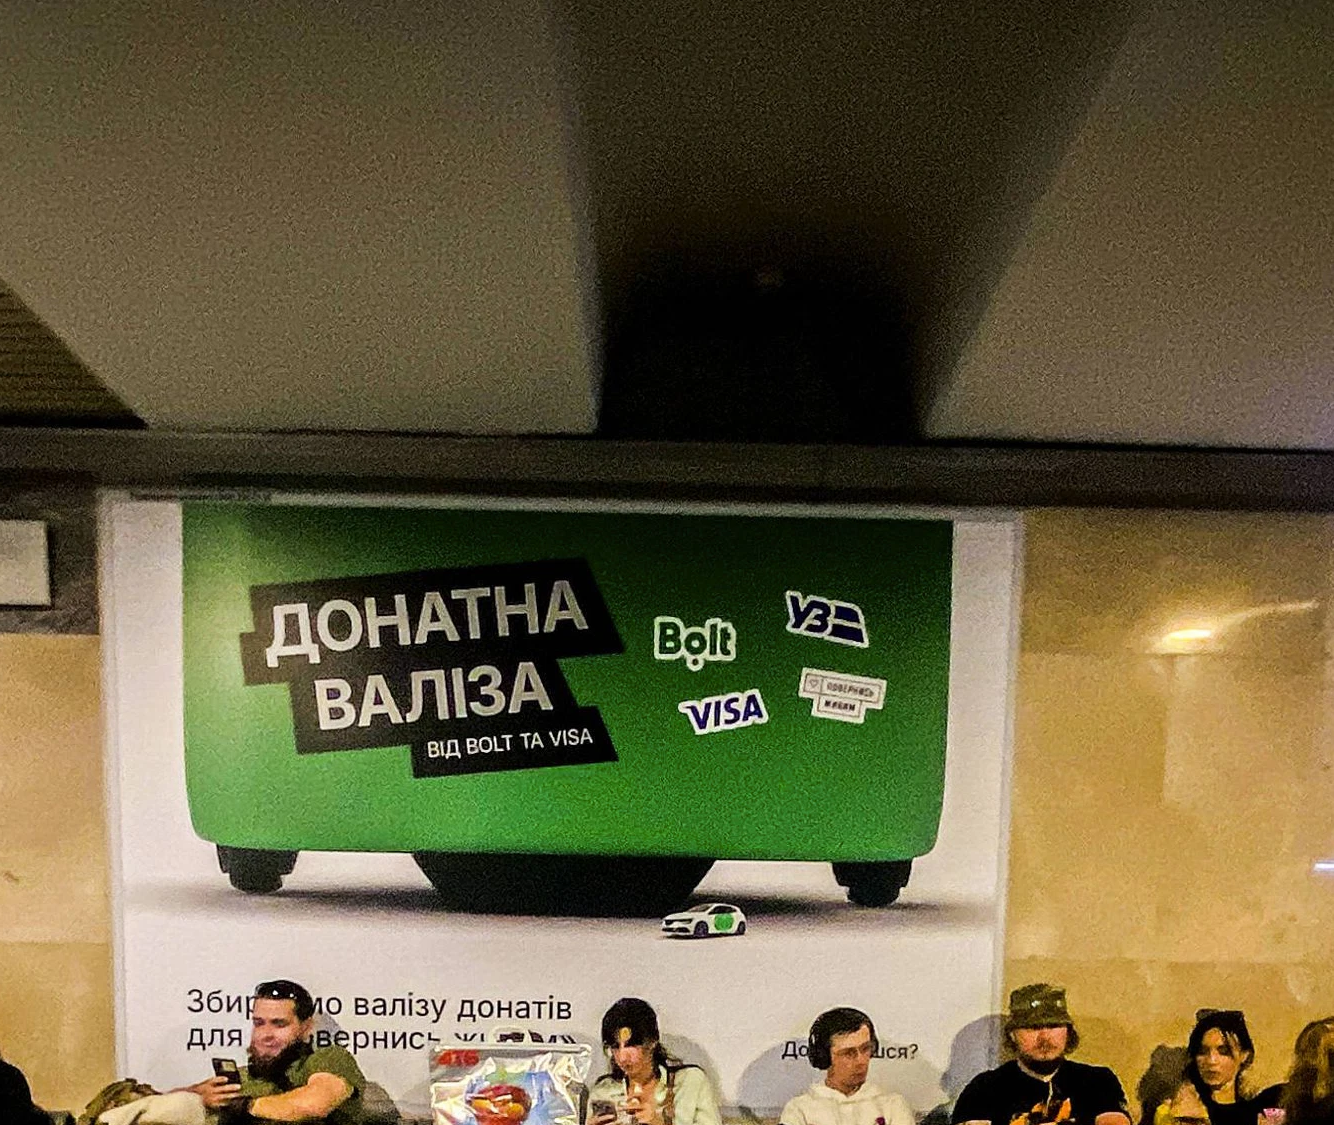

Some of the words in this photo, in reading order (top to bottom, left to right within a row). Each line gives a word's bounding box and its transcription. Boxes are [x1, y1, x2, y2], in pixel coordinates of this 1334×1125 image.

[265, 579, 589, 668] ДОНАТНА
[658, 620, 732, 665] Bolt
[313, 661, 554, 731] ВАЛІЗА
[686, 693, 764, 731] VISA
[427, 739, 462, 760] ВІД
[466, 734, 513, 755] BOLT
[519, 732, 545, 750] ТА
[548, 728, 594, 747] VISA
[187, 988, 343, 1020] Збирмо
[354, 992, 448, 1024] валізу
[456, 994, 572, 1023] донатів
[186, 1028, 243, 1051] для
[310, 1029, 441, 1056] вернись
[781, 1040, 919, 1061] Дошся?
